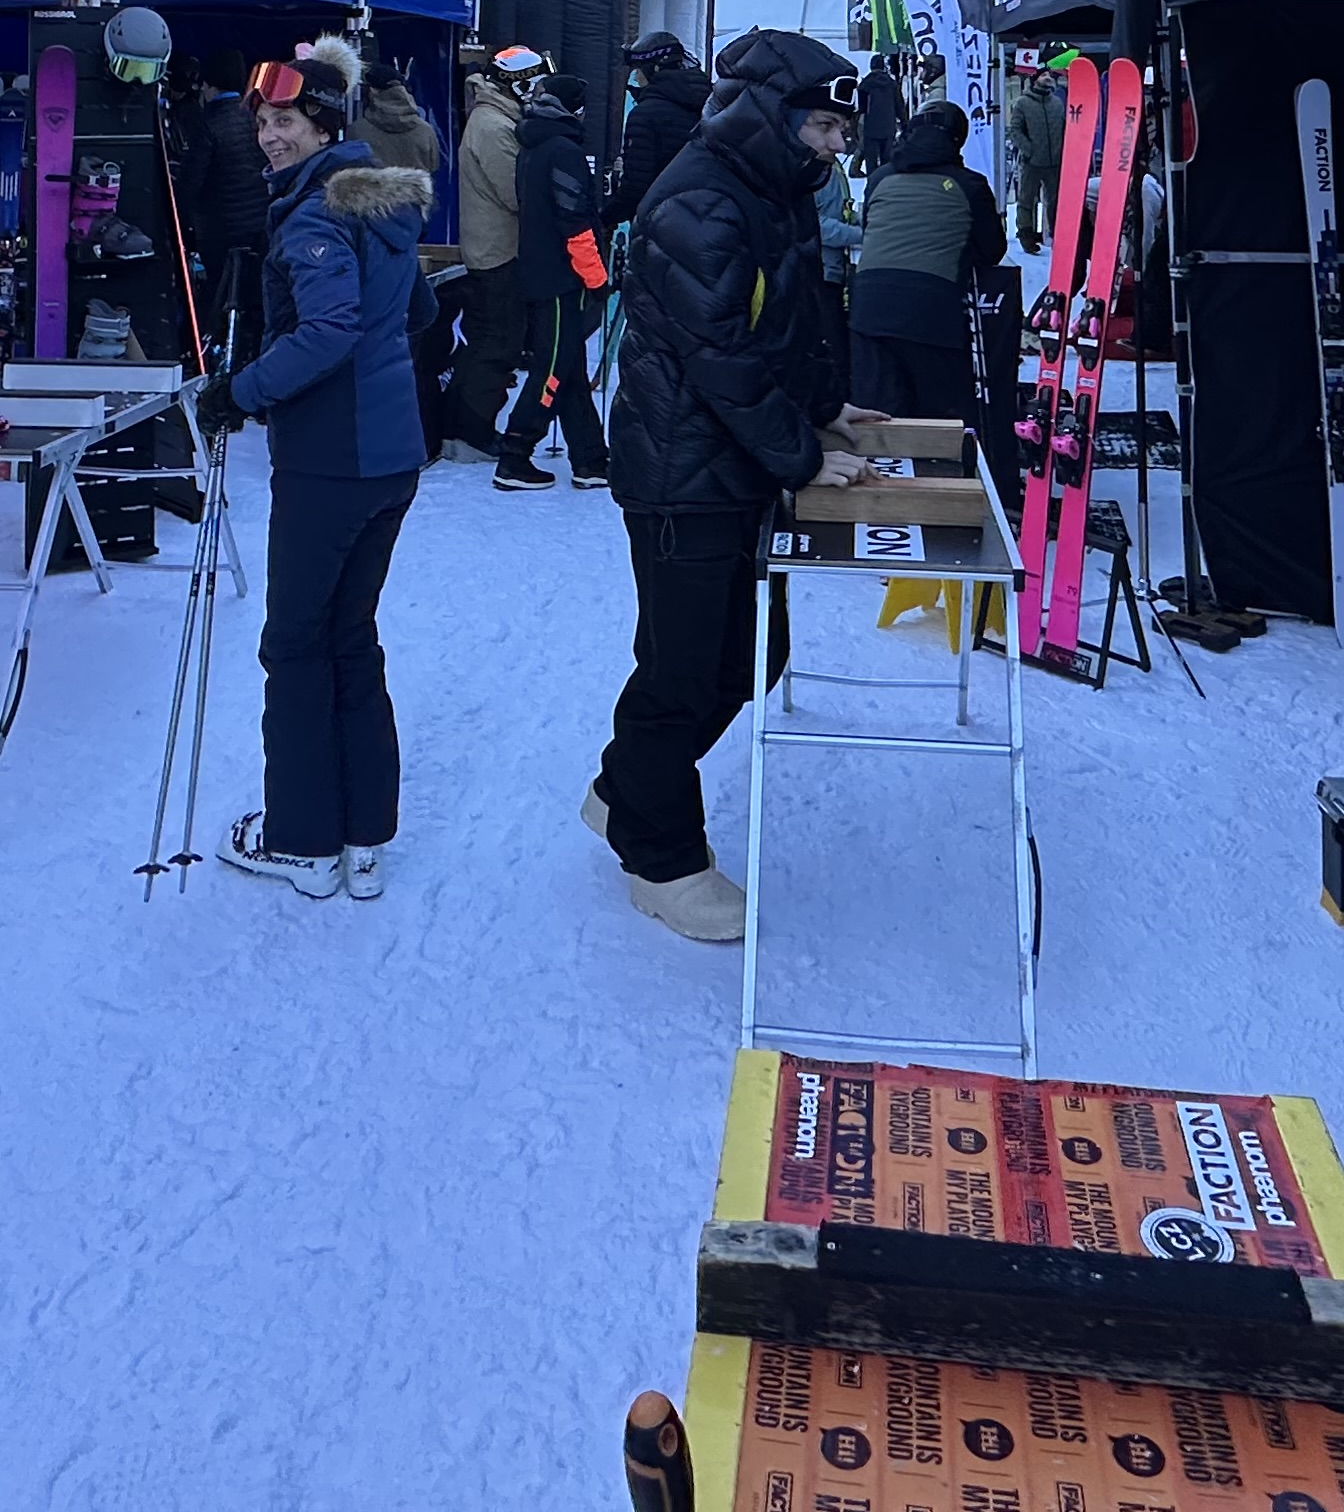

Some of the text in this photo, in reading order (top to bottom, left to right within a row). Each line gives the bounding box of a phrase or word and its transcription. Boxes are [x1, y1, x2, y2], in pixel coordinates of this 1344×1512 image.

[1117, 106, 1137, 172] FACTION
[1313, 127, 1332, 192] FACTION
[910, 1146, 933, 1159] IS
[1028, 1162, 1053, 1176] IS
[1143, 1157, 1167, 1172] IS
[1185, 1106, 1246, 1224] FACTION
[945, 1169, 969, 1191] MY
[968, 1172, 992, 1196] THE
[1062, 1179, 1087, 1202] MY
[1087, 1182, 1113, 1206] THE
[782, 1414, 809, 1429] IS
[1059, 1424, 1088, 1443] IS
[915, 1445, 943, 1466] IS
[1211, 1466, 1244, 1487] IS
